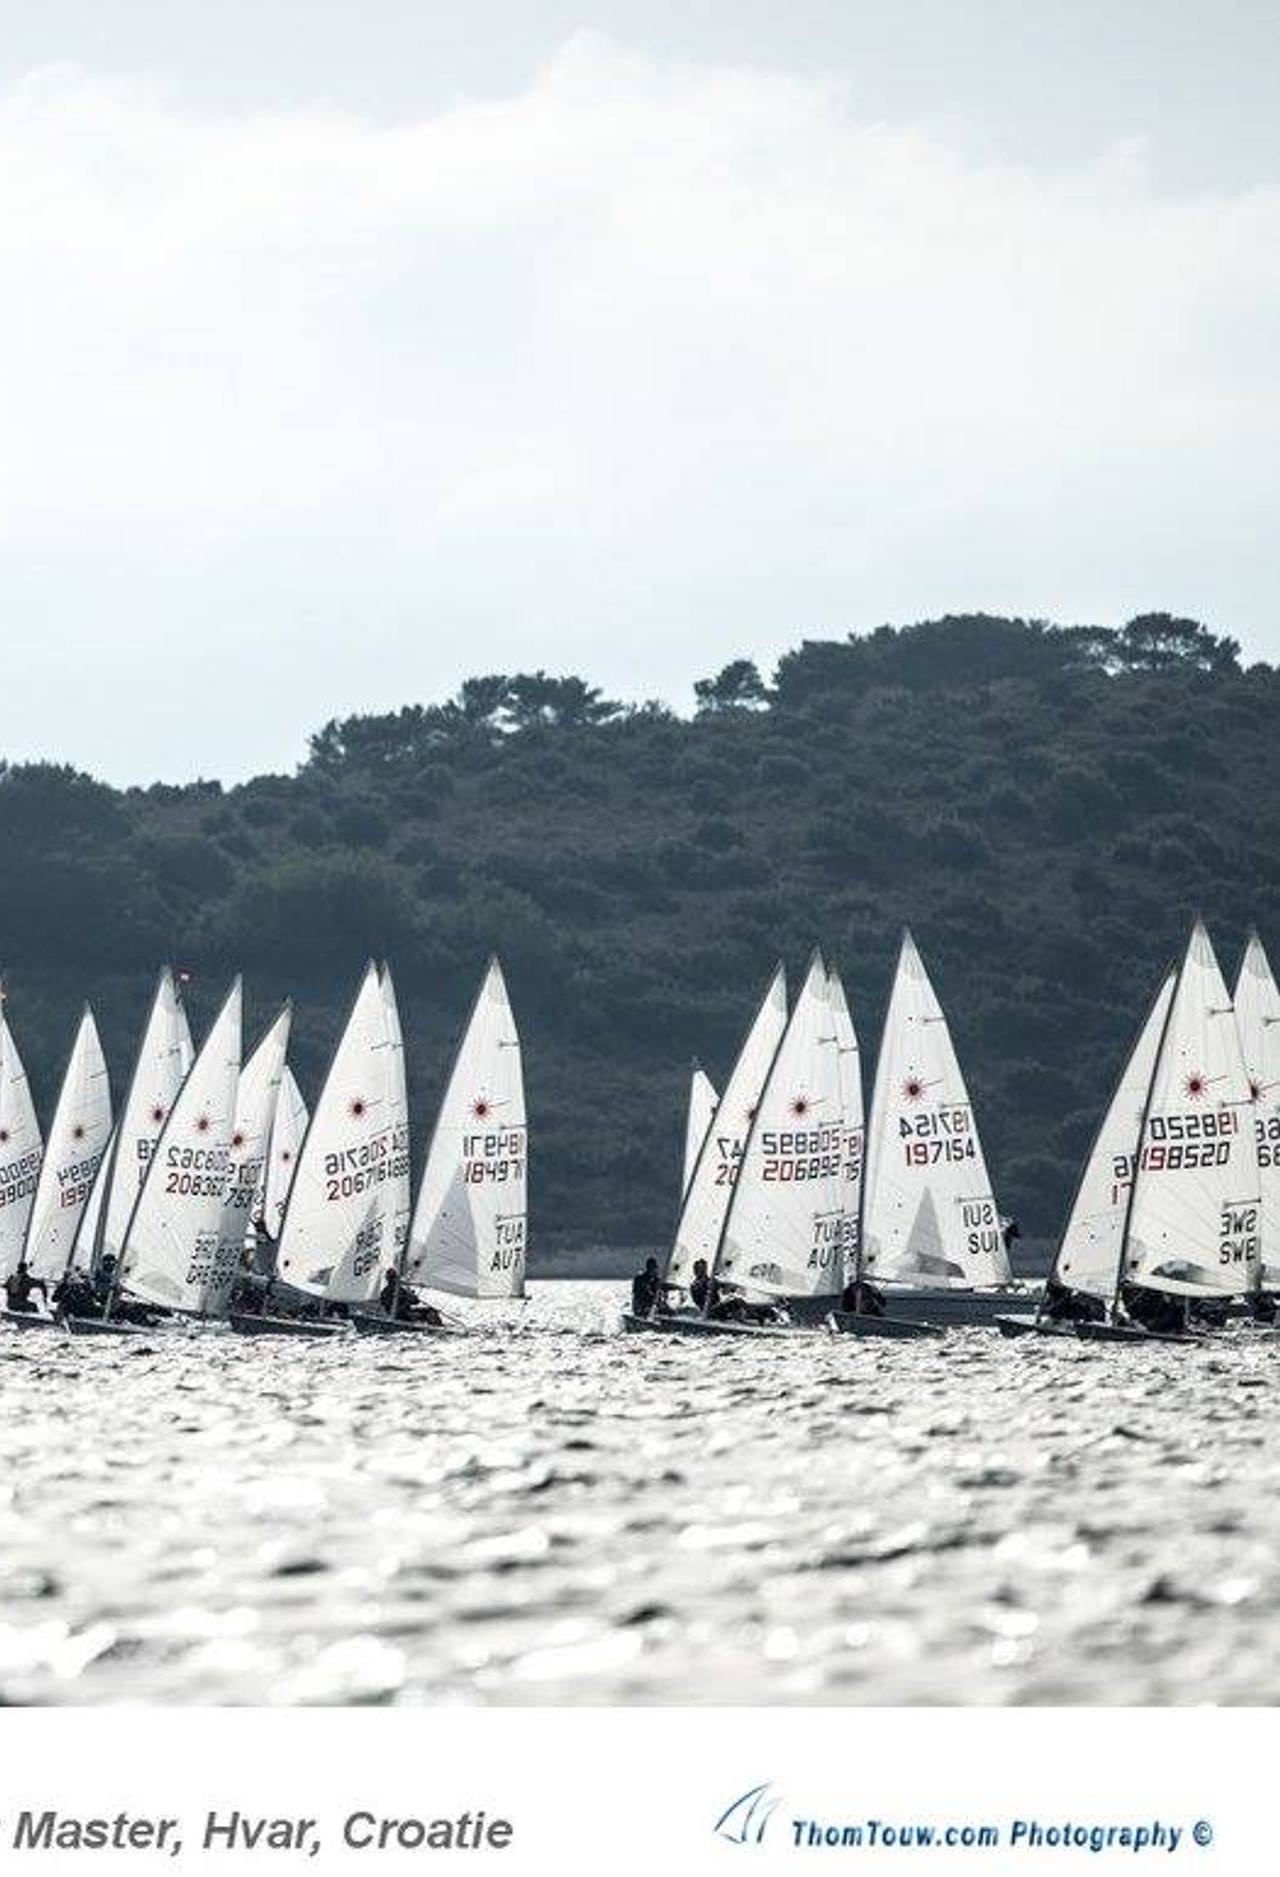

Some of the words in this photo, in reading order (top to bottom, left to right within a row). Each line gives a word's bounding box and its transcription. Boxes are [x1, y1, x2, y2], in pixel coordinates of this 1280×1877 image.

[905, 1139, 975, 1166] 197154
[1142, 1142, 1230, 1171] 198520
[968, 1231, 999, 1255] SUI
[1219, 1237, 1257, 1264] SWE
